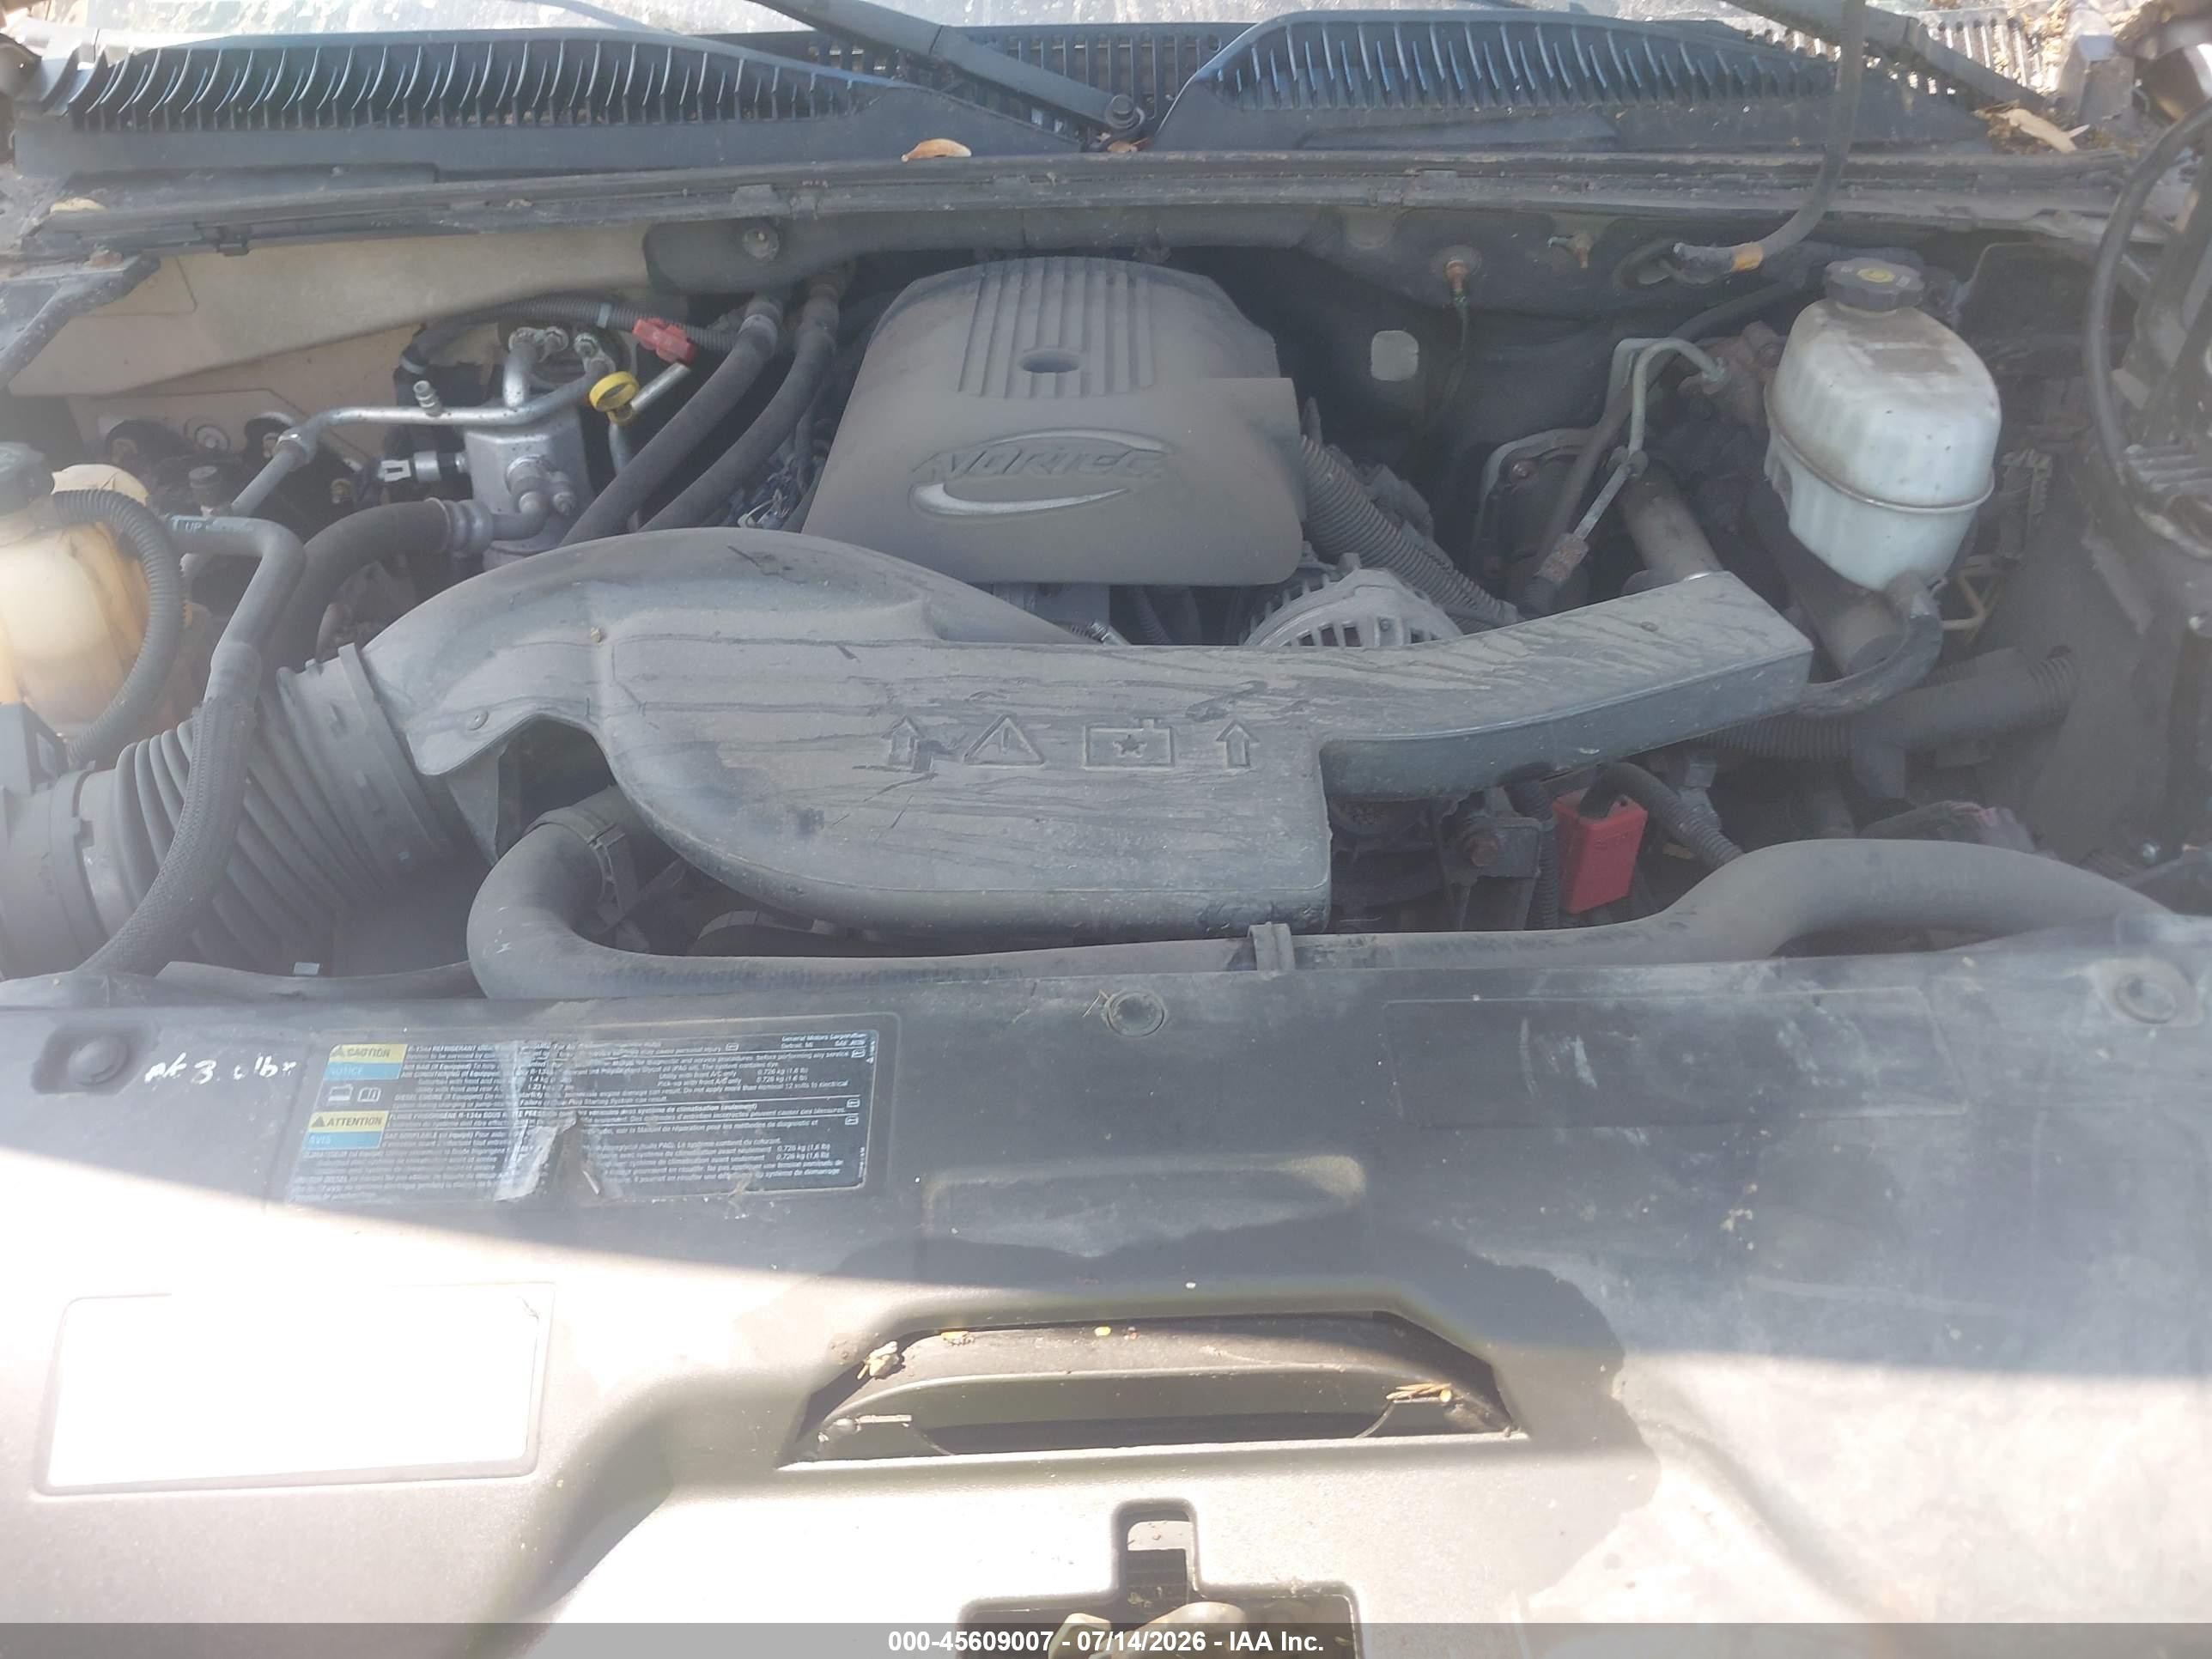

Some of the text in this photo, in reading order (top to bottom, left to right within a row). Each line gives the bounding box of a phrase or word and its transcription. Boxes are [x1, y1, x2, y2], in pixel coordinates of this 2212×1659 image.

[914, 447, 1164, 480] VORTEC
[347, 1047, 392, 1058] CAUTION
[327, 1117, 383, 1127] ATTENTION
